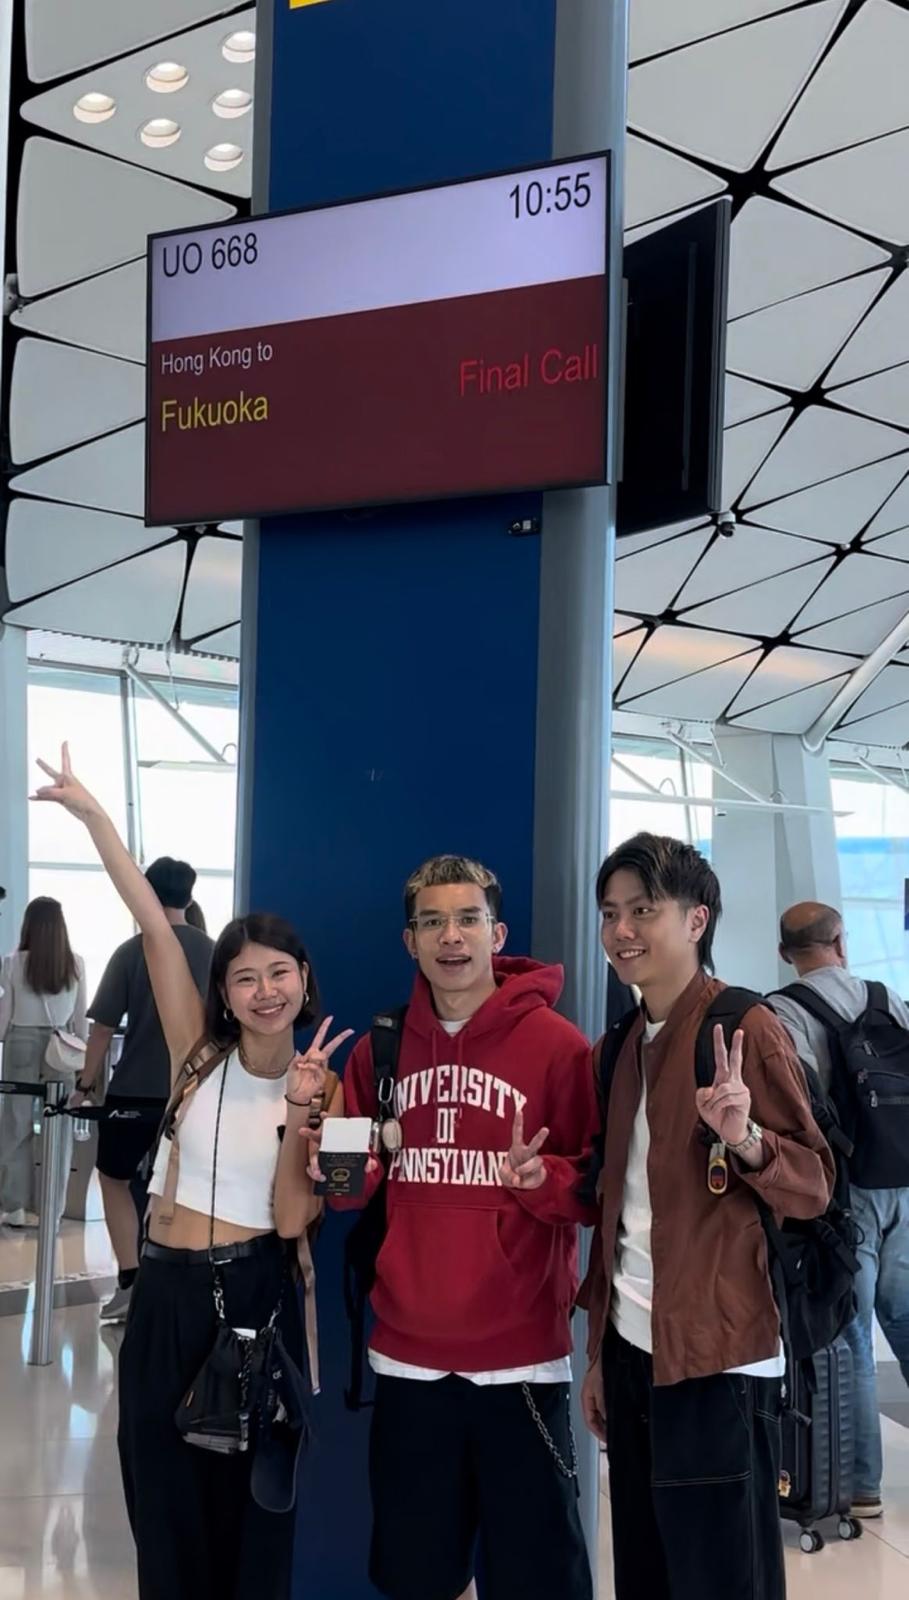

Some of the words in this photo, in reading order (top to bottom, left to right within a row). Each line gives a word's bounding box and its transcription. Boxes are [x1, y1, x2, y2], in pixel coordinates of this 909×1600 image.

[508, 171, 592, 219] 10:55
[162, 241, 203, 278] UO
[211, 232, 259, 270] 668
[160, 351, 204, 376] Hong
[208, 345, 252, 371] Kong
[256, 341, 274, 363] to
[459, 352, 530, 397] Final
[540, 343, 598, 384] Call
[160, 390, 269, 433] Fukuoka
[393, 1064, 527, 1119] NIVERSITY
[436, 1107, 462, 1144] OF
